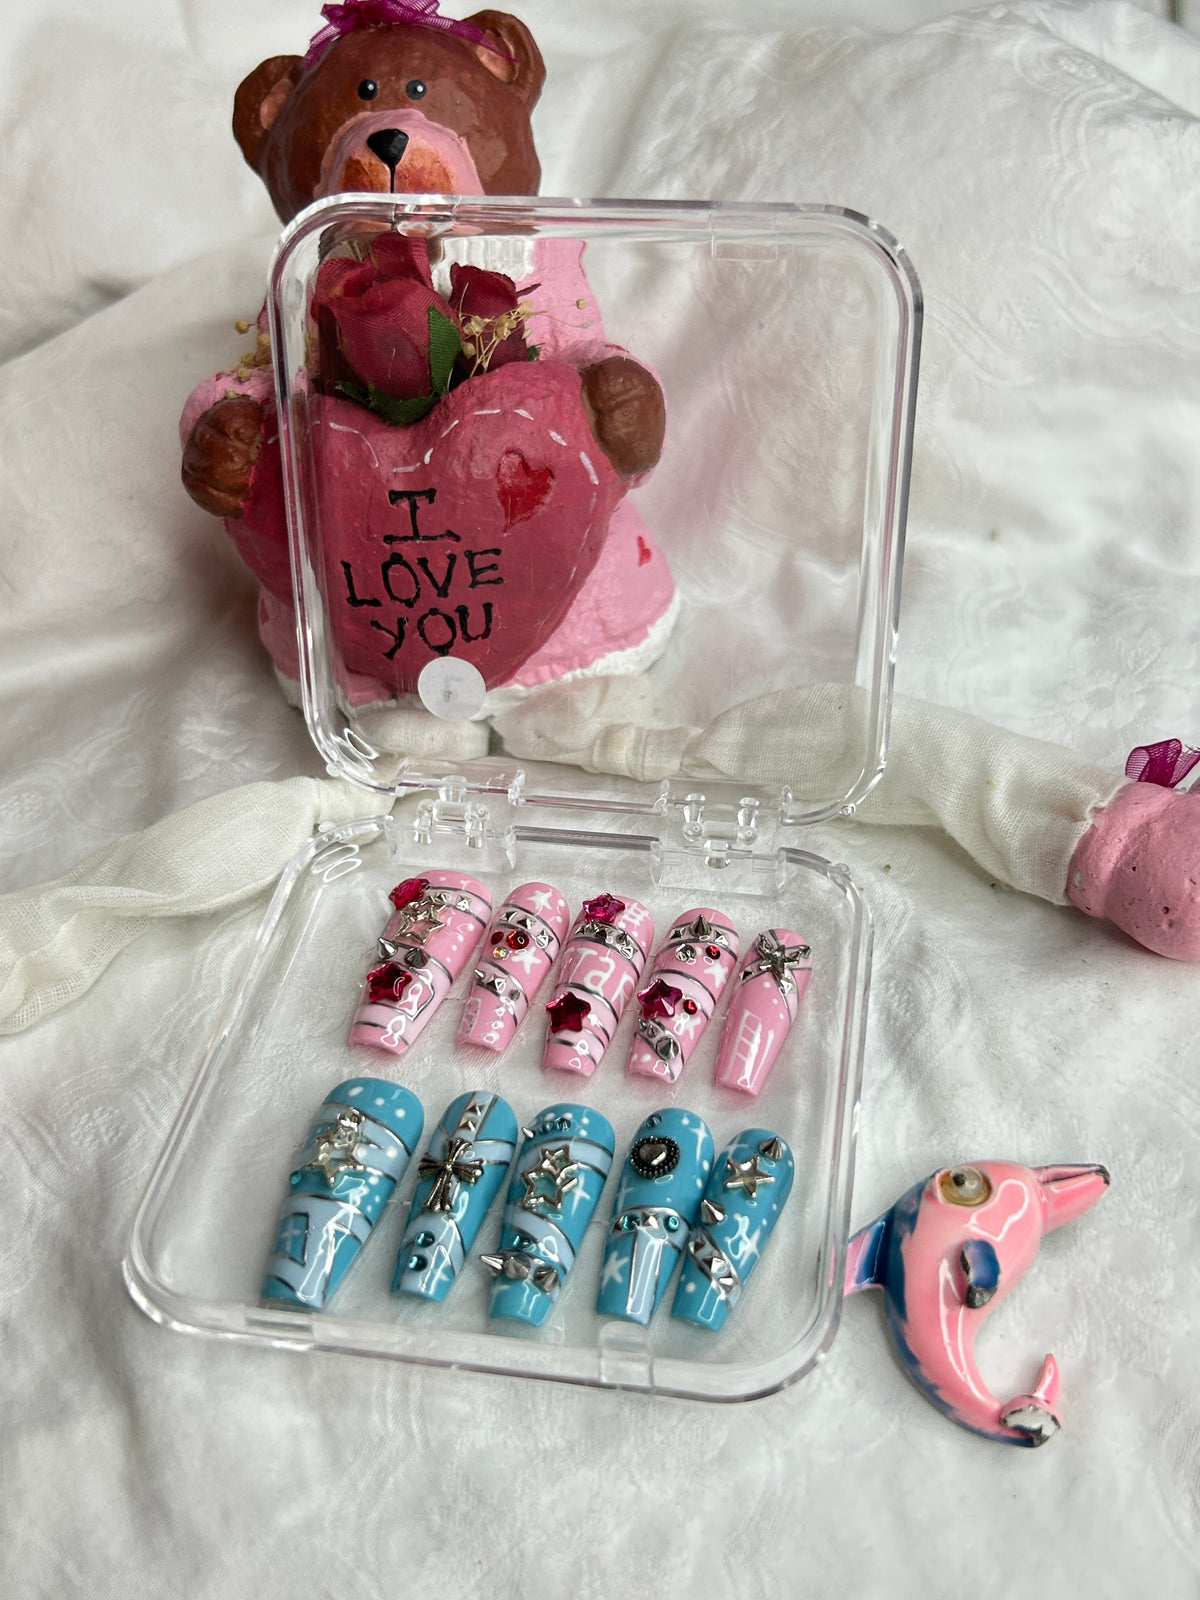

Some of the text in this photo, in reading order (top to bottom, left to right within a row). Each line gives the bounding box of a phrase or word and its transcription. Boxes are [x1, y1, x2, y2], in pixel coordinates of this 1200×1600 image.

[383, 487, 461, 545] I
[340, 548, 504, 608] LOVE
[370, 602, 494, 661] YOU
